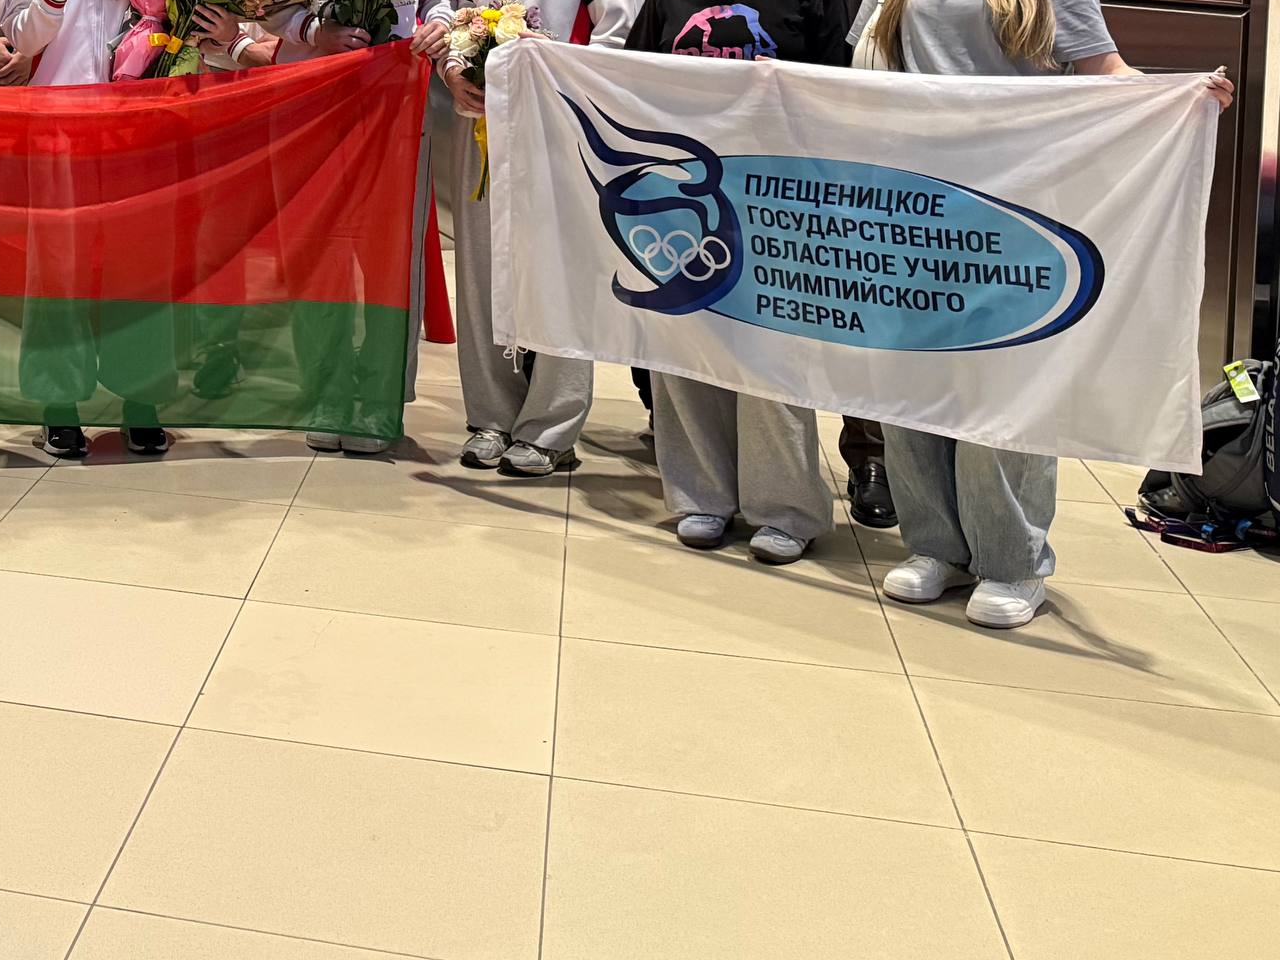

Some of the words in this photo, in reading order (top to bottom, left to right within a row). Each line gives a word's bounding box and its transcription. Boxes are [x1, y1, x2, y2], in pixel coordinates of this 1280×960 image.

[743, 173, 946, 219] ПЛЕЩЕНИЦКОЕ
[747, 205, 1003, 255] ГОСУДАРСТВЕННОЕ
[750, 234, 898, 278] ОБЛАСТНОЕ
[903, 254, 1052, 294] УЧИЛИЩЕ
[753, 263, 966, 314] ОЛИМПИЙСКОГО
[755, 293, 866, 334] РЕЗЕРВА
